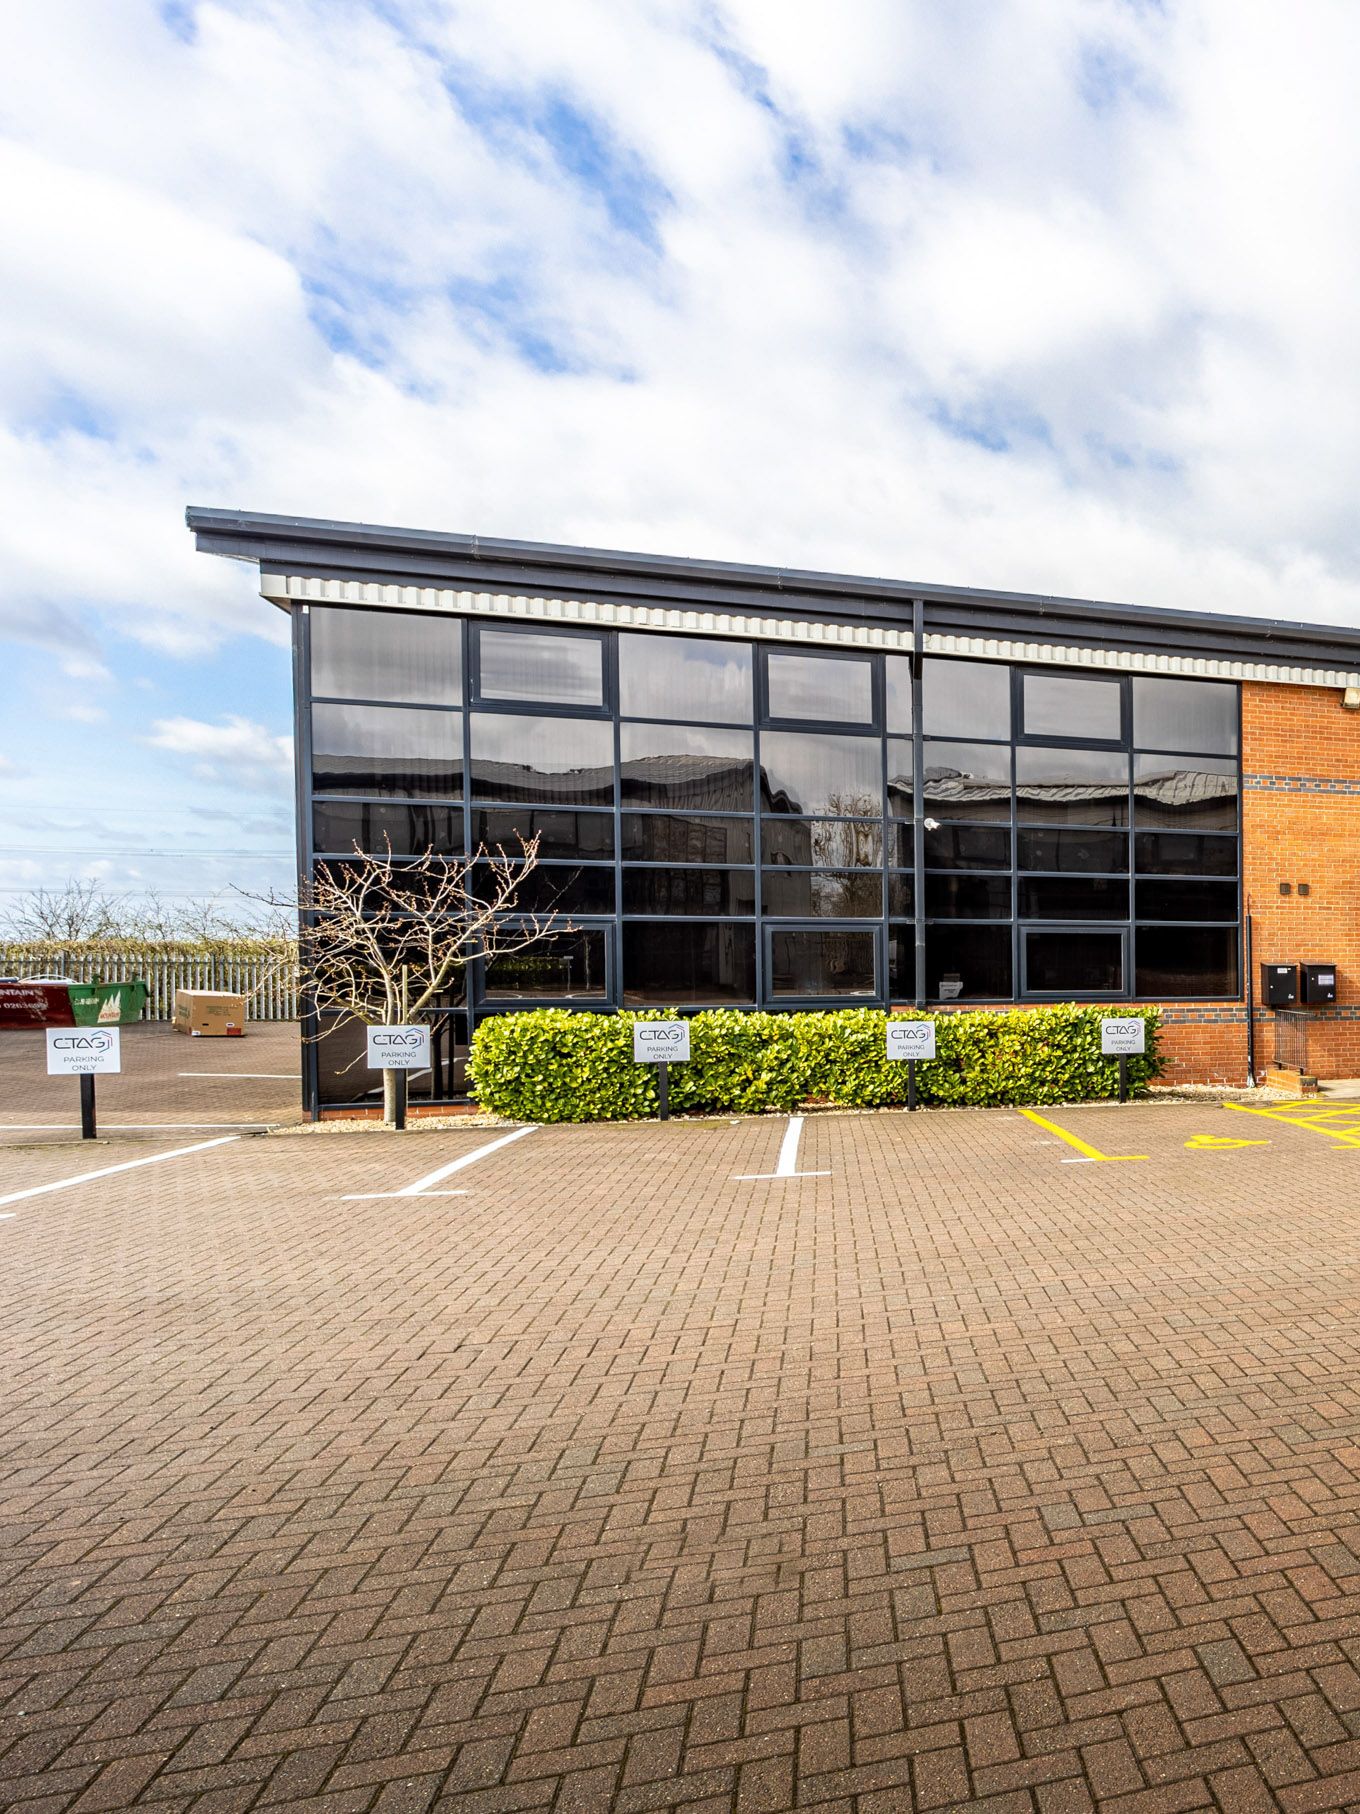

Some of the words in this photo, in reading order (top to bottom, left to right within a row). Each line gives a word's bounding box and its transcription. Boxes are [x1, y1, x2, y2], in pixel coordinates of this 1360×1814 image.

[639, 1029, 680, 1041] CTAG
[890, 1029, 926, 1039] CTAG
[1105, 1025, 1137, 1035] CTAG
[53, 1037, 106, 1049] CTAG
[372, 1034, 418, 1046] CTAG
